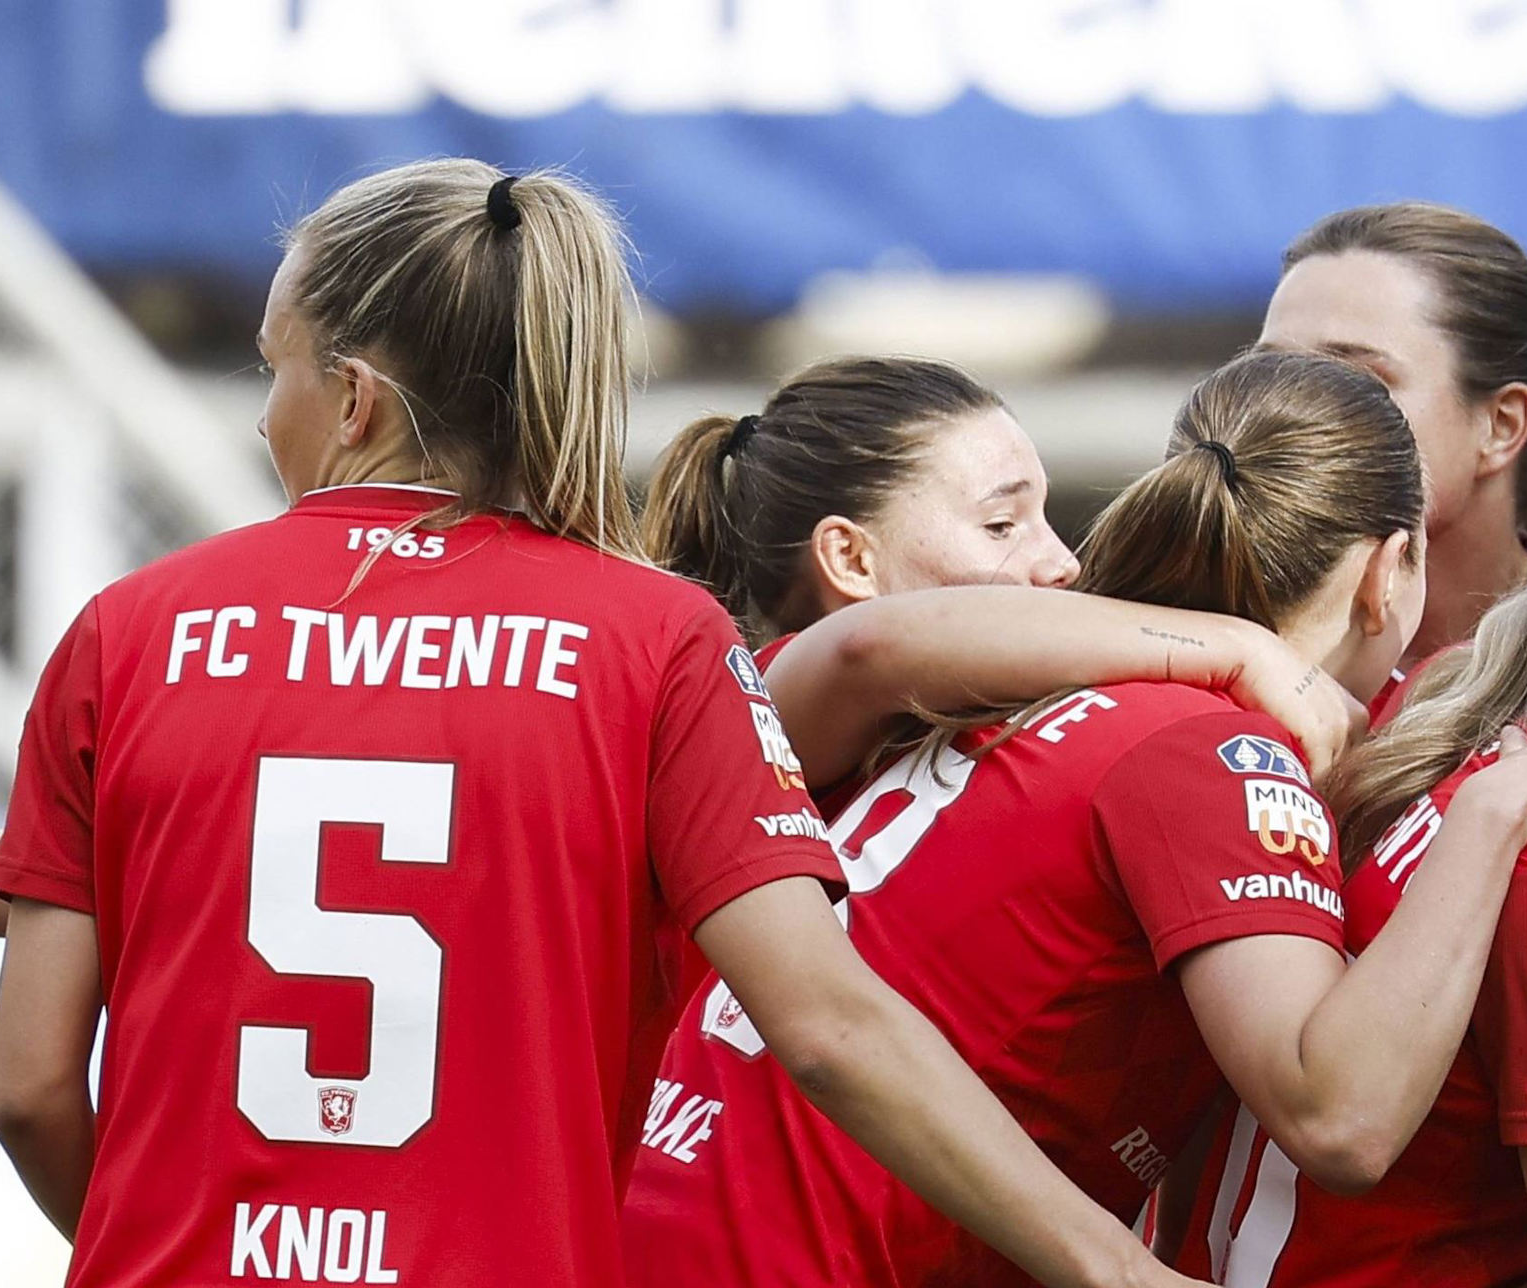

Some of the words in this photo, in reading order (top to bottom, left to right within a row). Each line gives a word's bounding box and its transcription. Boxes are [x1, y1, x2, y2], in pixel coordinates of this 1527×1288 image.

[346, 526, 447, 561] 1965
[166, 605, 257, 686] FC
[281, 605, 589, 700] TWENTE
[1258, 809, 1326, 867] US
[1220, 870, 1345, 920] vanhuu
[235, 755, 456, 1149] 5
[229, 1203, 398, 1284] KNOL
